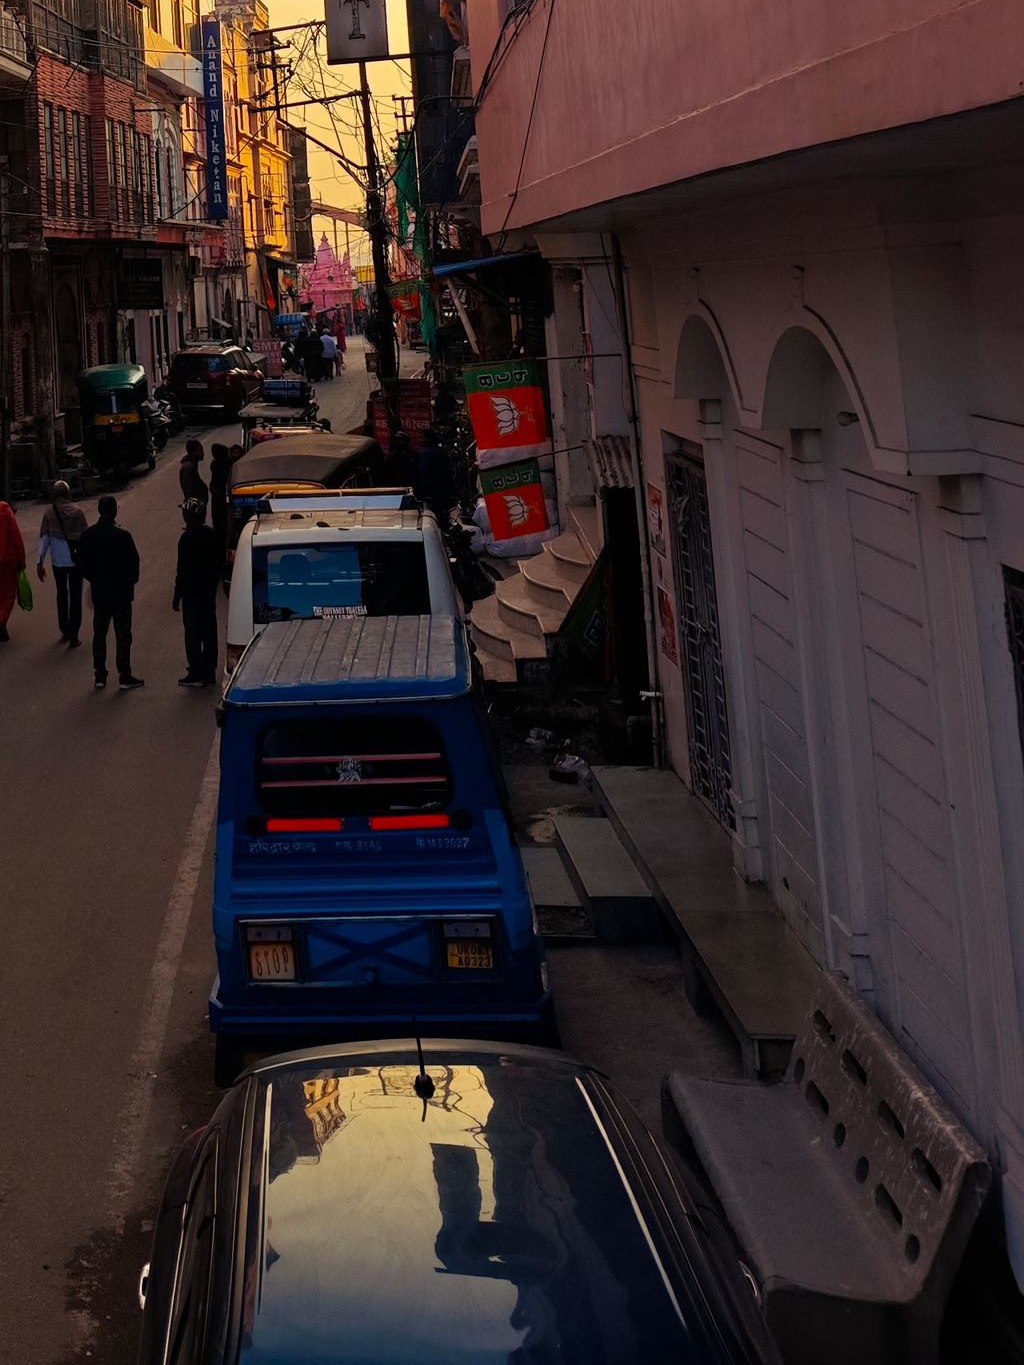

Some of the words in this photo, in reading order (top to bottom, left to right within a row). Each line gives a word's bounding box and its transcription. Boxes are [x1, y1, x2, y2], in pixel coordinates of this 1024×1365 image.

[207, 35, 217, 97] Anand
[210, 109, 222, 203] Niketan
[256, 945, 289, 976] STOP
